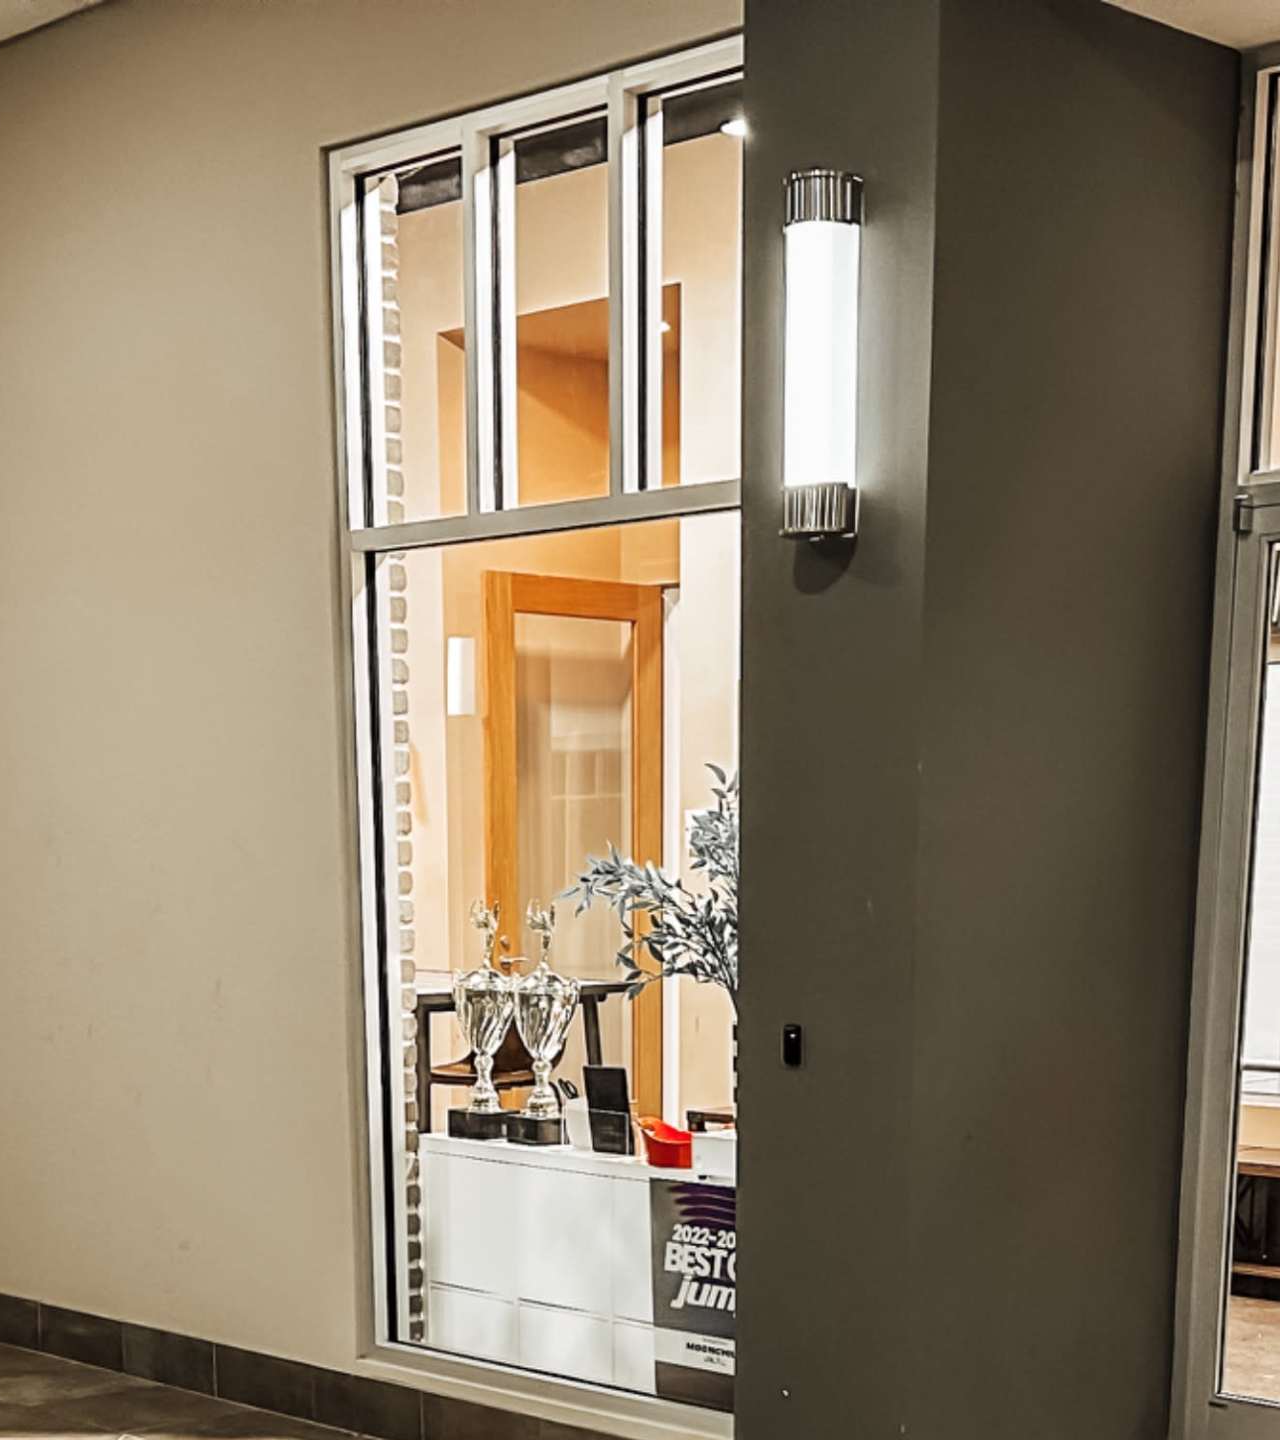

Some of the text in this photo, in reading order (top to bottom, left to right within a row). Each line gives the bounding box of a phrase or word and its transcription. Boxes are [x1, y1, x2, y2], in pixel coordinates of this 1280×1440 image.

[672, 1223, 736, 1249] 2022-20
[664, 1241, 728, 1279] BEST
[670, 1275, 736, 1319] jum
